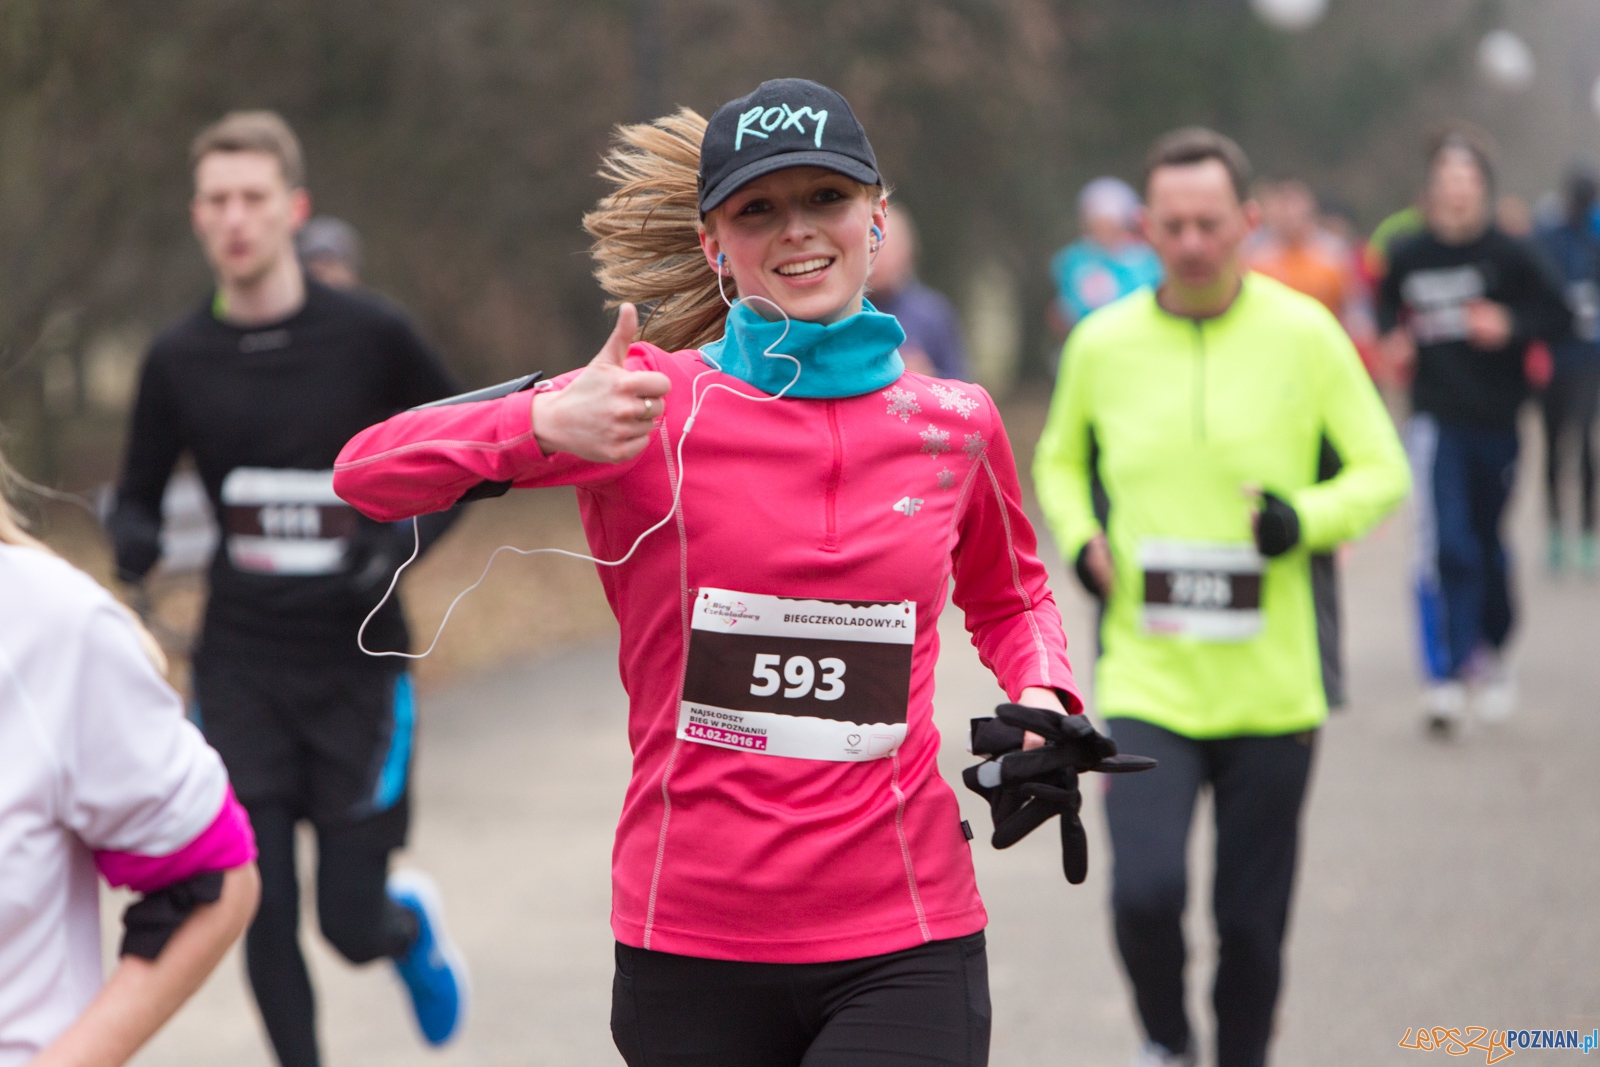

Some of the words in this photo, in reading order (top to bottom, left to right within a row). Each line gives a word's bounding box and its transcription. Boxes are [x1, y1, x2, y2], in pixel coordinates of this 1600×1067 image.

[734, 103, 828, 151] ROXY
[893, 496, 925, 516] 4F
[703, 607, 760, 621] Czekoladowy
[712, 602, 731, 611] Bieg
[783, 613, 907, 629] BIEGCZEKOLADOWY.PL
[750, 653, 847, 701] 593
[689, 715, 709, 725] BIEG
[711, 719, 720, 727] W
[721, 721, 767, 735] POZNANIU
[690, 707, 744, 723] NAJSŁODSZY
[689, 725, 754, 747] 14.02.2016
[755, 739, 766, 749] r.
